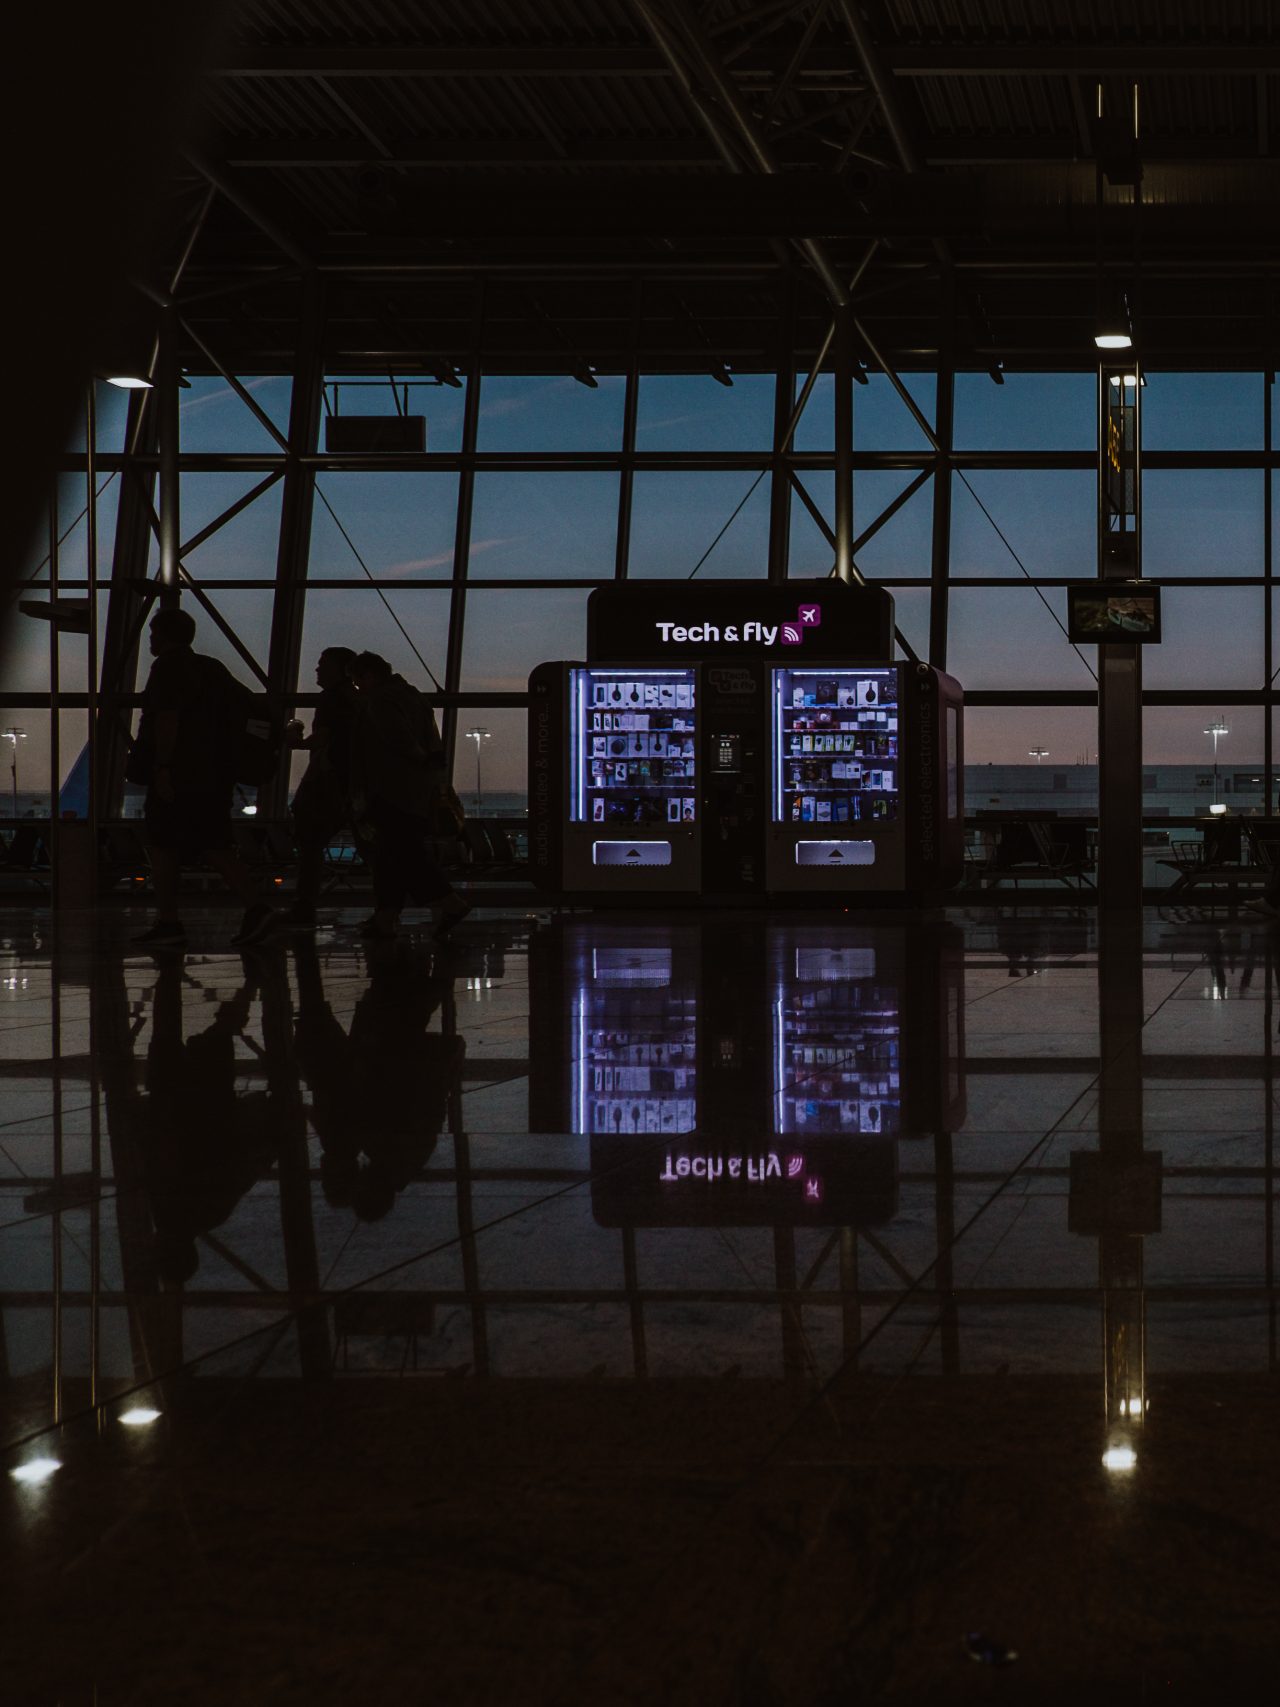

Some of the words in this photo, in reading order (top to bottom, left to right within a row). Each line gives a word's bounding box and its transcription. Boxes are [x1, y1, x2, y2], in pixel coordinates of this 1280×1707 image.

[656, 622, 719, 643] Tech
[723, 625, 740, 643] &
[919, 702, 933, 790] electronics
[535, 773, 549, 817] video
[919, 794, 934, 861] selected
